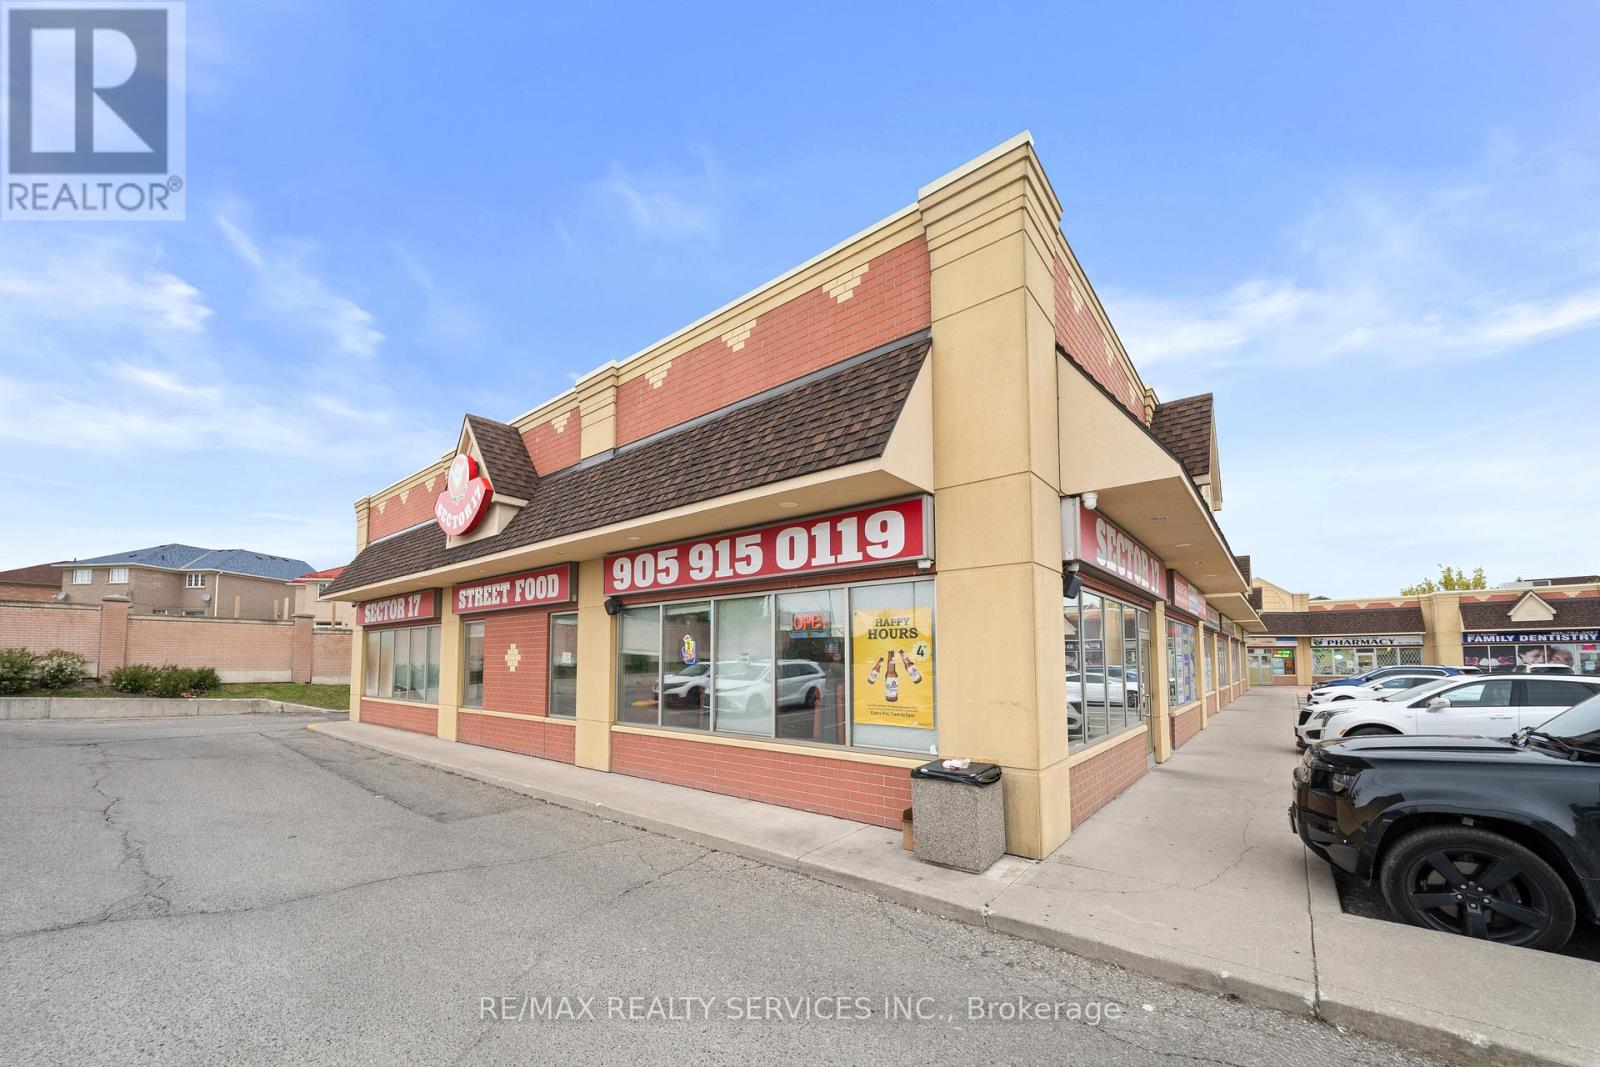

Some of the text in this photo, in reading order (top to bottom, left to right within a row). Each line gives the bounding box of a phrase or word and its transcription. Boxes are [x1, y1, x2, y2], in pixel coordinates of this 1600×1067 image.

[437, 503, 473, 529] SECTOR
[612, 510, 906, 590] 905 915 0119
[1095, 517, 1149, 589] SECTOR
[458, 573, 559, 609] STREET FOOD
[364, 594, 420, 624] SECTOR 17
[875, 617, 910, 627] HAPPY
[867, 627, 919, 640] HOURS
[1467, 633, 1599, 642] FAMILY DENTISTRY
